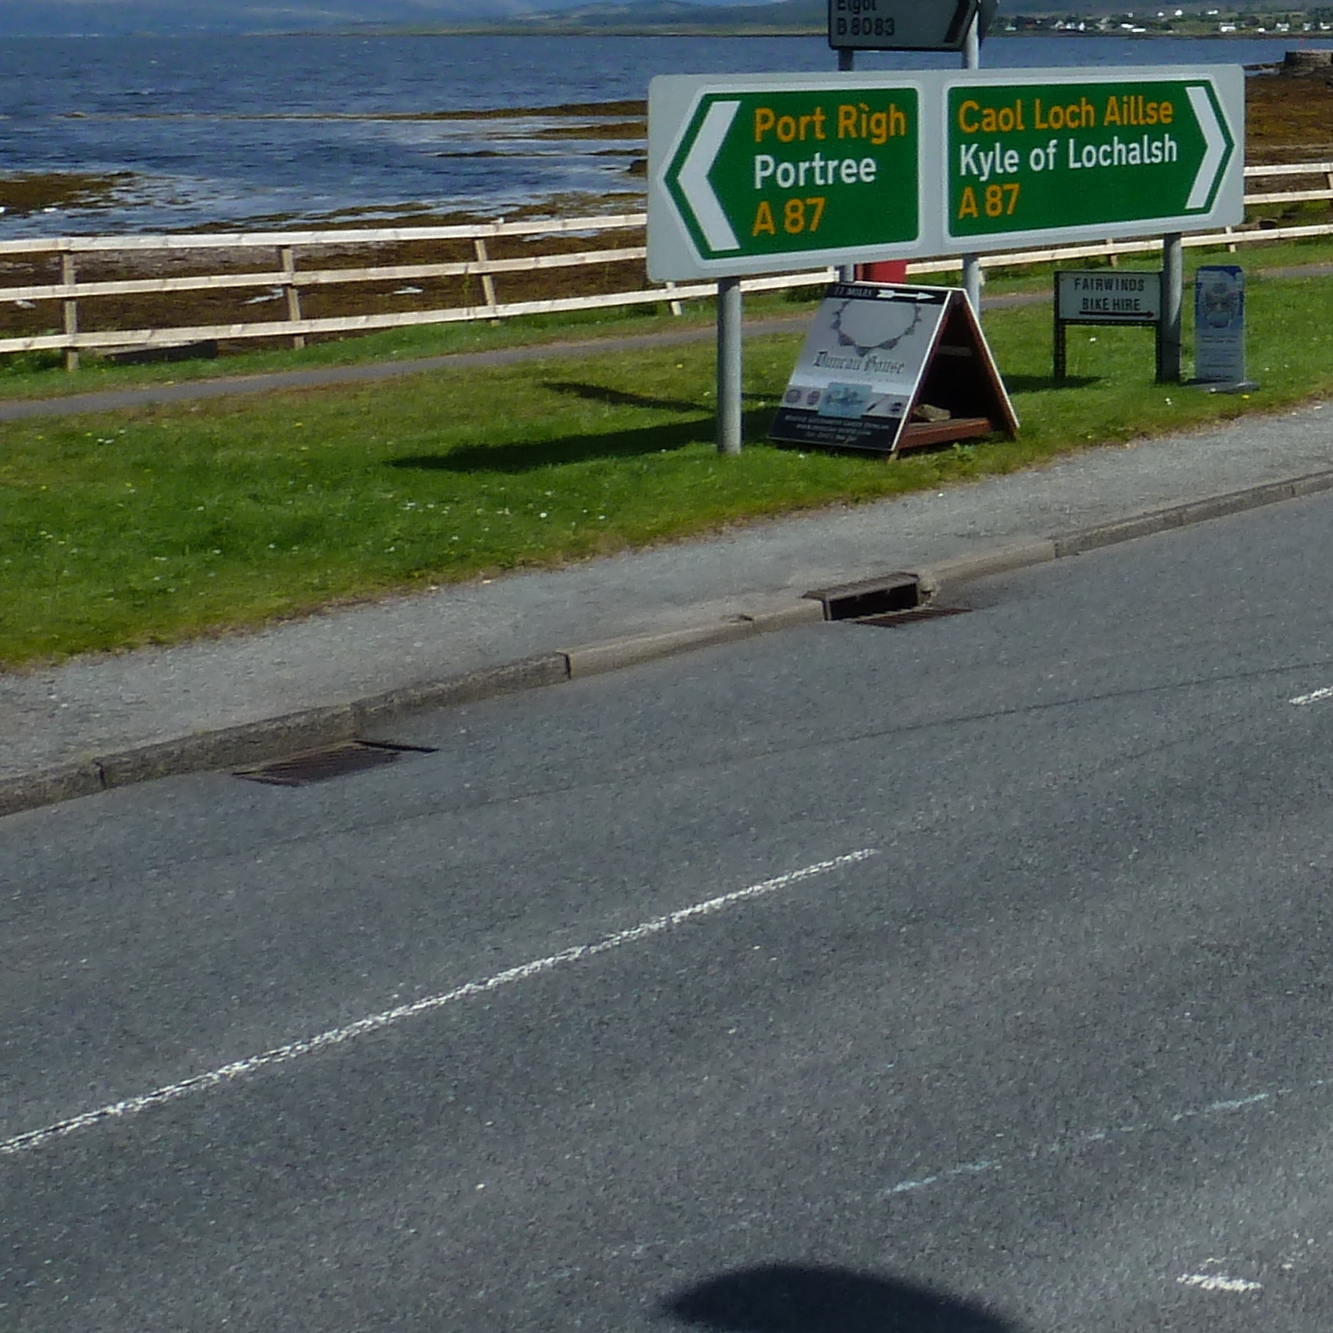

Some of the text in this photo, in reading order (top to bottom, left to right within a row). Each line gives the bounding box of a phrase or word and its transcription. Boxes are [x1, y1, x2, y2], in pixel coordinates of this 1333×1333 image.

[754, 102, 907, 145] Port Rìgh
[958, 95, 1174, 134] Caol Loch Aillse
[754, 152, 877, 189] Portree
[959, 134, 1178, 182] Kyle of Lochalsh
[1074, 277, 1145, 292] FAIRWINDS
[1082, 298, 1141, 312] BIKE HIRE
